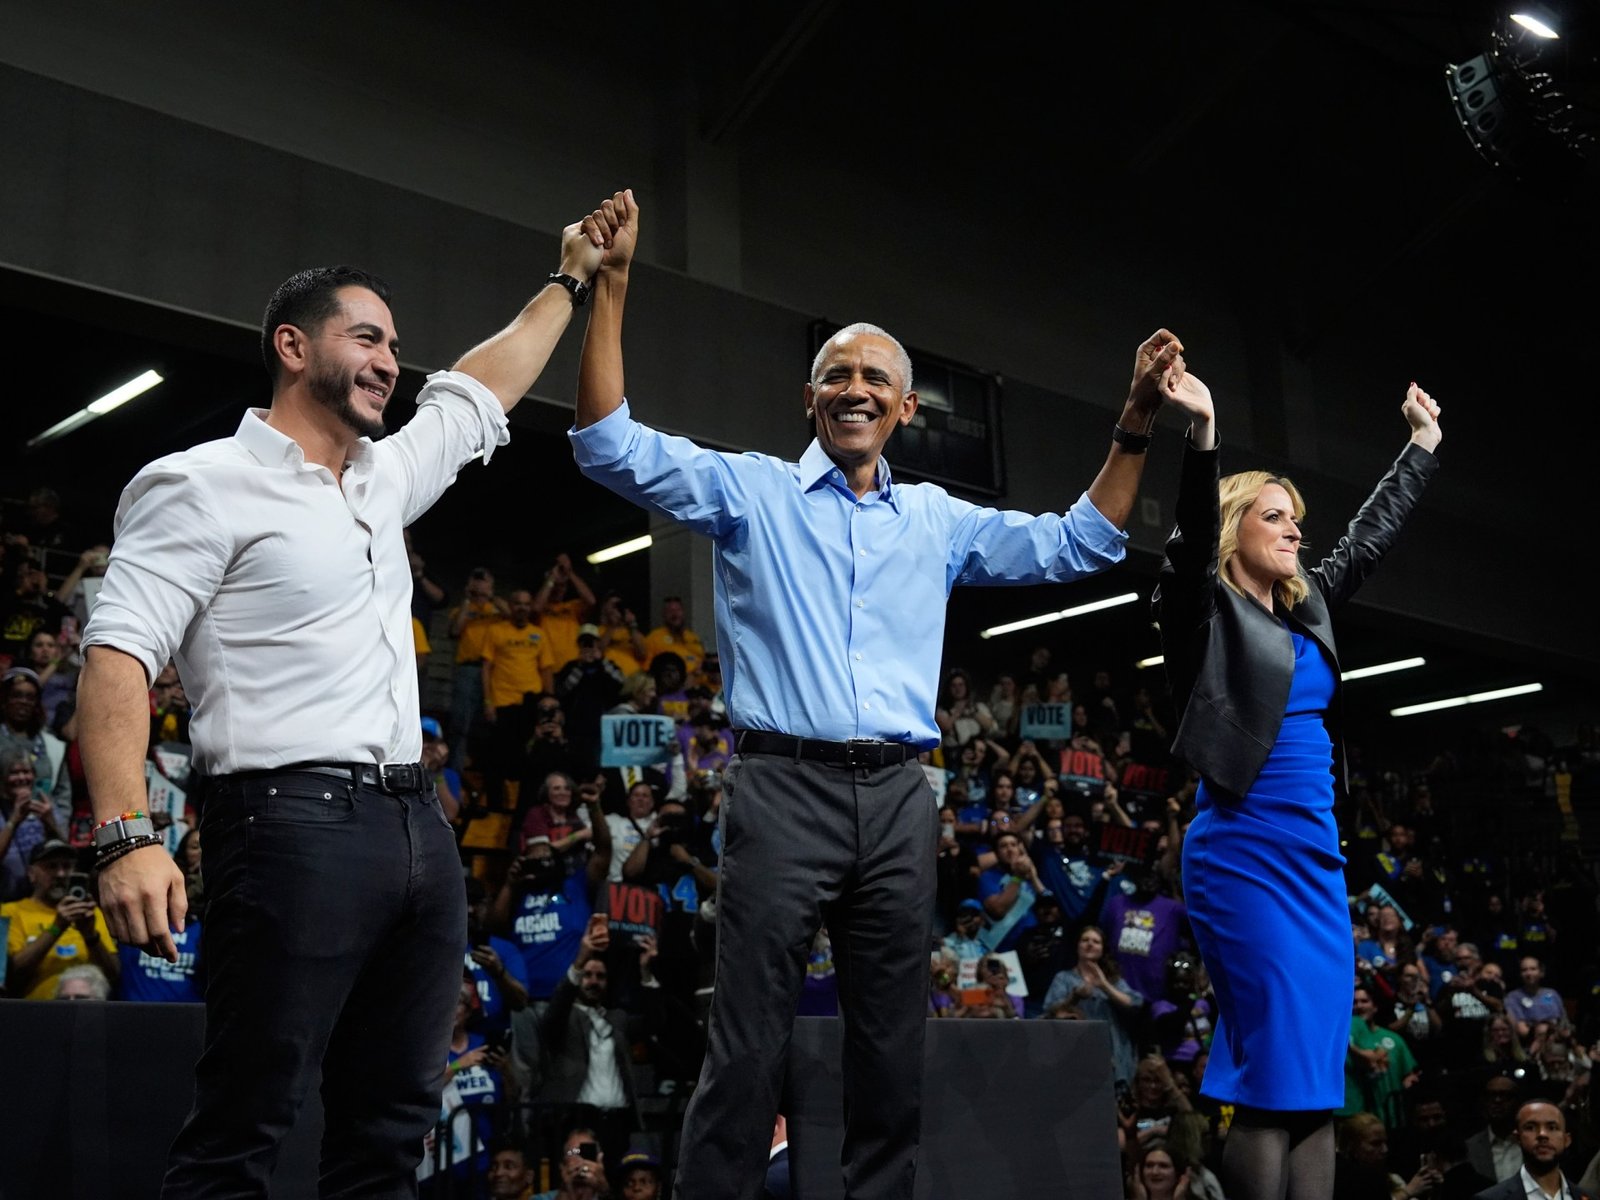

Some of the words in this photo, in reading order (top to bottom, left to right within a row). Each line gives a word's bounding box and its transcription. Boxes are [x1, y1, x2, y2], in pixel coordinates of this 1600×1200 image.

[1026, 706, 1064, 725] VOTE
[613, 719, 666, 747] VOTE
[1059, 750, 1105, 779] VOTE
[1122, 762, 1168, 793] VOTE
[609, 883, 665, 928] VOT
